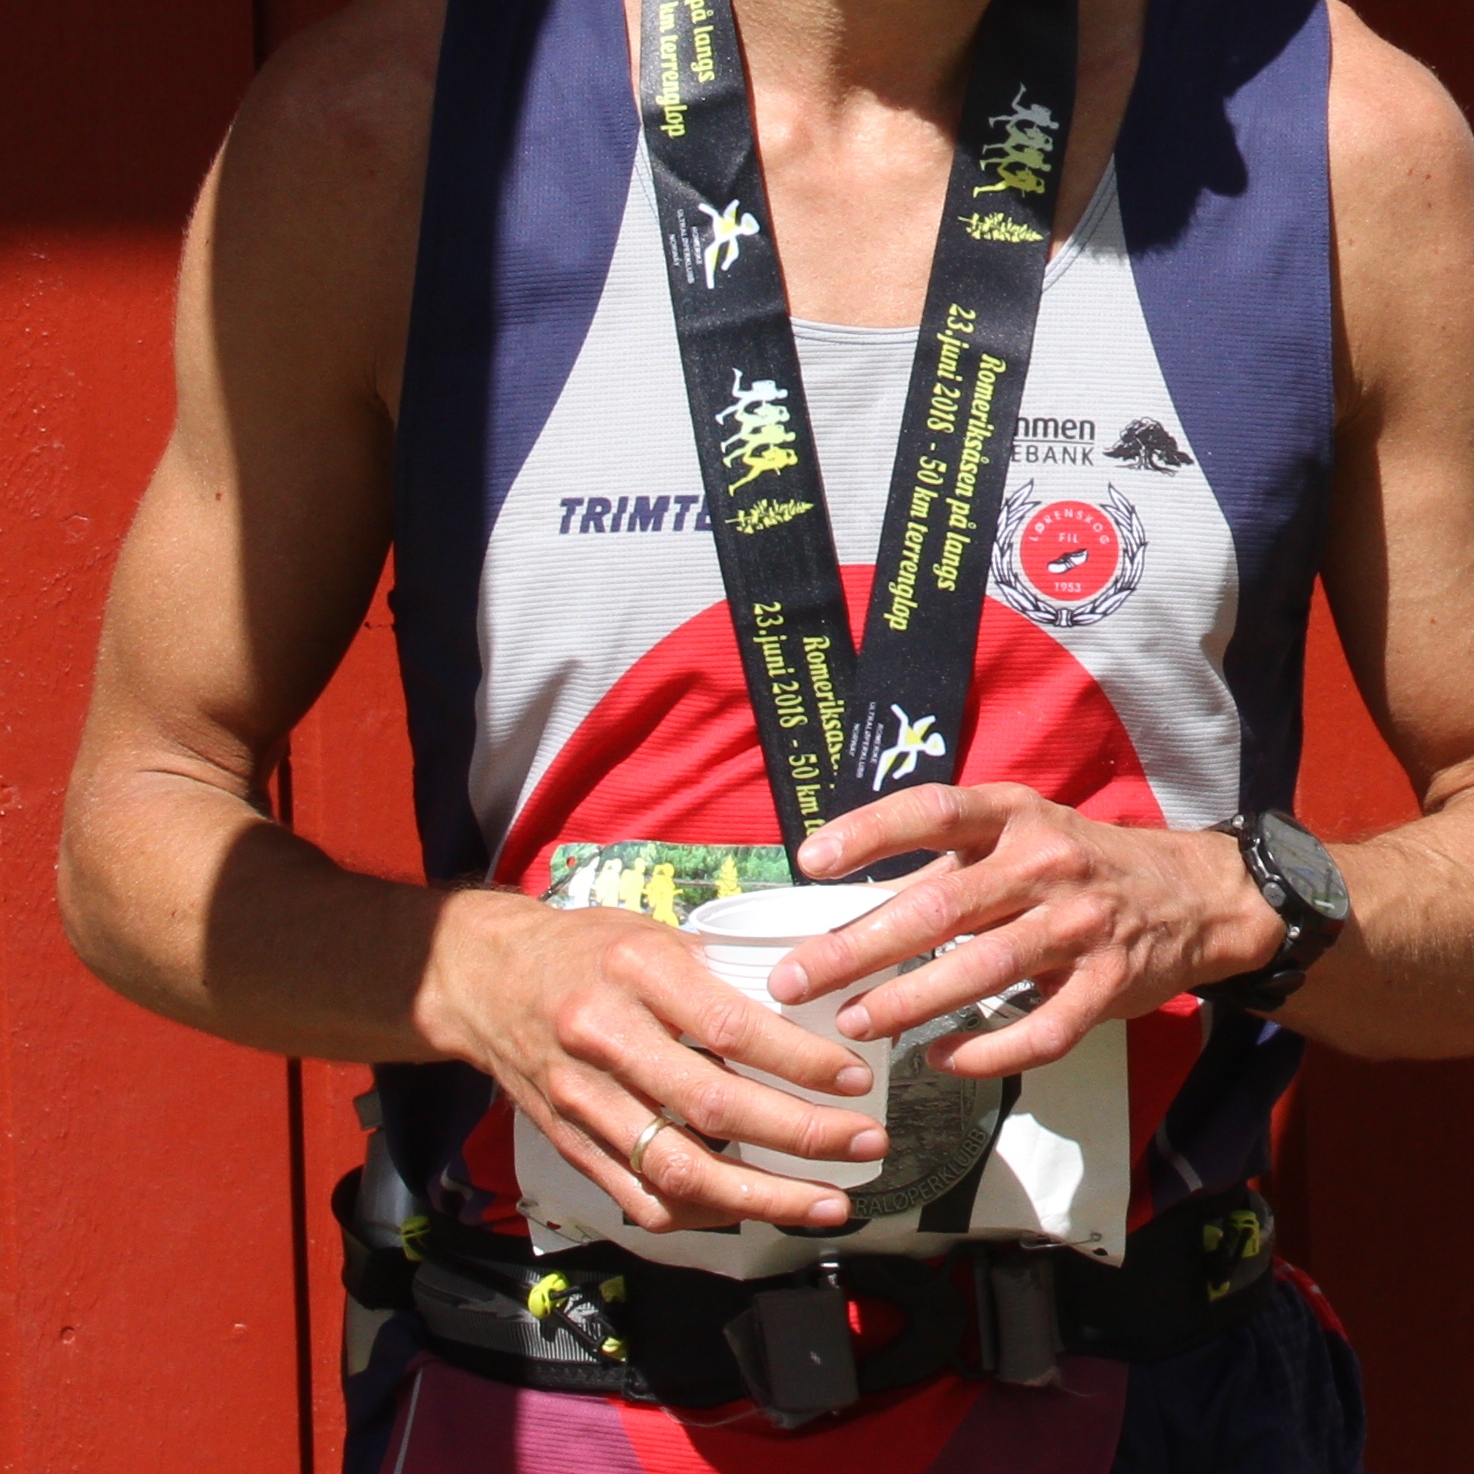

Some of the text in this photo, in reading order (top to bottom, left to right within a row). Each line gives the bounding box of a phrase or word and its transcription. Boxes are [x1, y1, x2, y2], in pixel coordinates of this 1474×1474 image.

[659, 2, 679, 33] km
[693, 26, 716, 83] langs
[937, 303, 976, 381] 23.juni
[927, 383, 961, 433] 2018
[919, 456, 947, 486] 50
[933, 353, 1007, 592] Romeriksåsen på langs
[914, 486, 939, 520] km
[1058, 533, 1079, 544] FIL
[1054, 581, 1082, 593] 1953
[753, 601, 795, 678] 23.juni
[773, 681, 808, 729] 2018
[788, 753, 820, 779] 50
[796, 784, 821, 816] km
